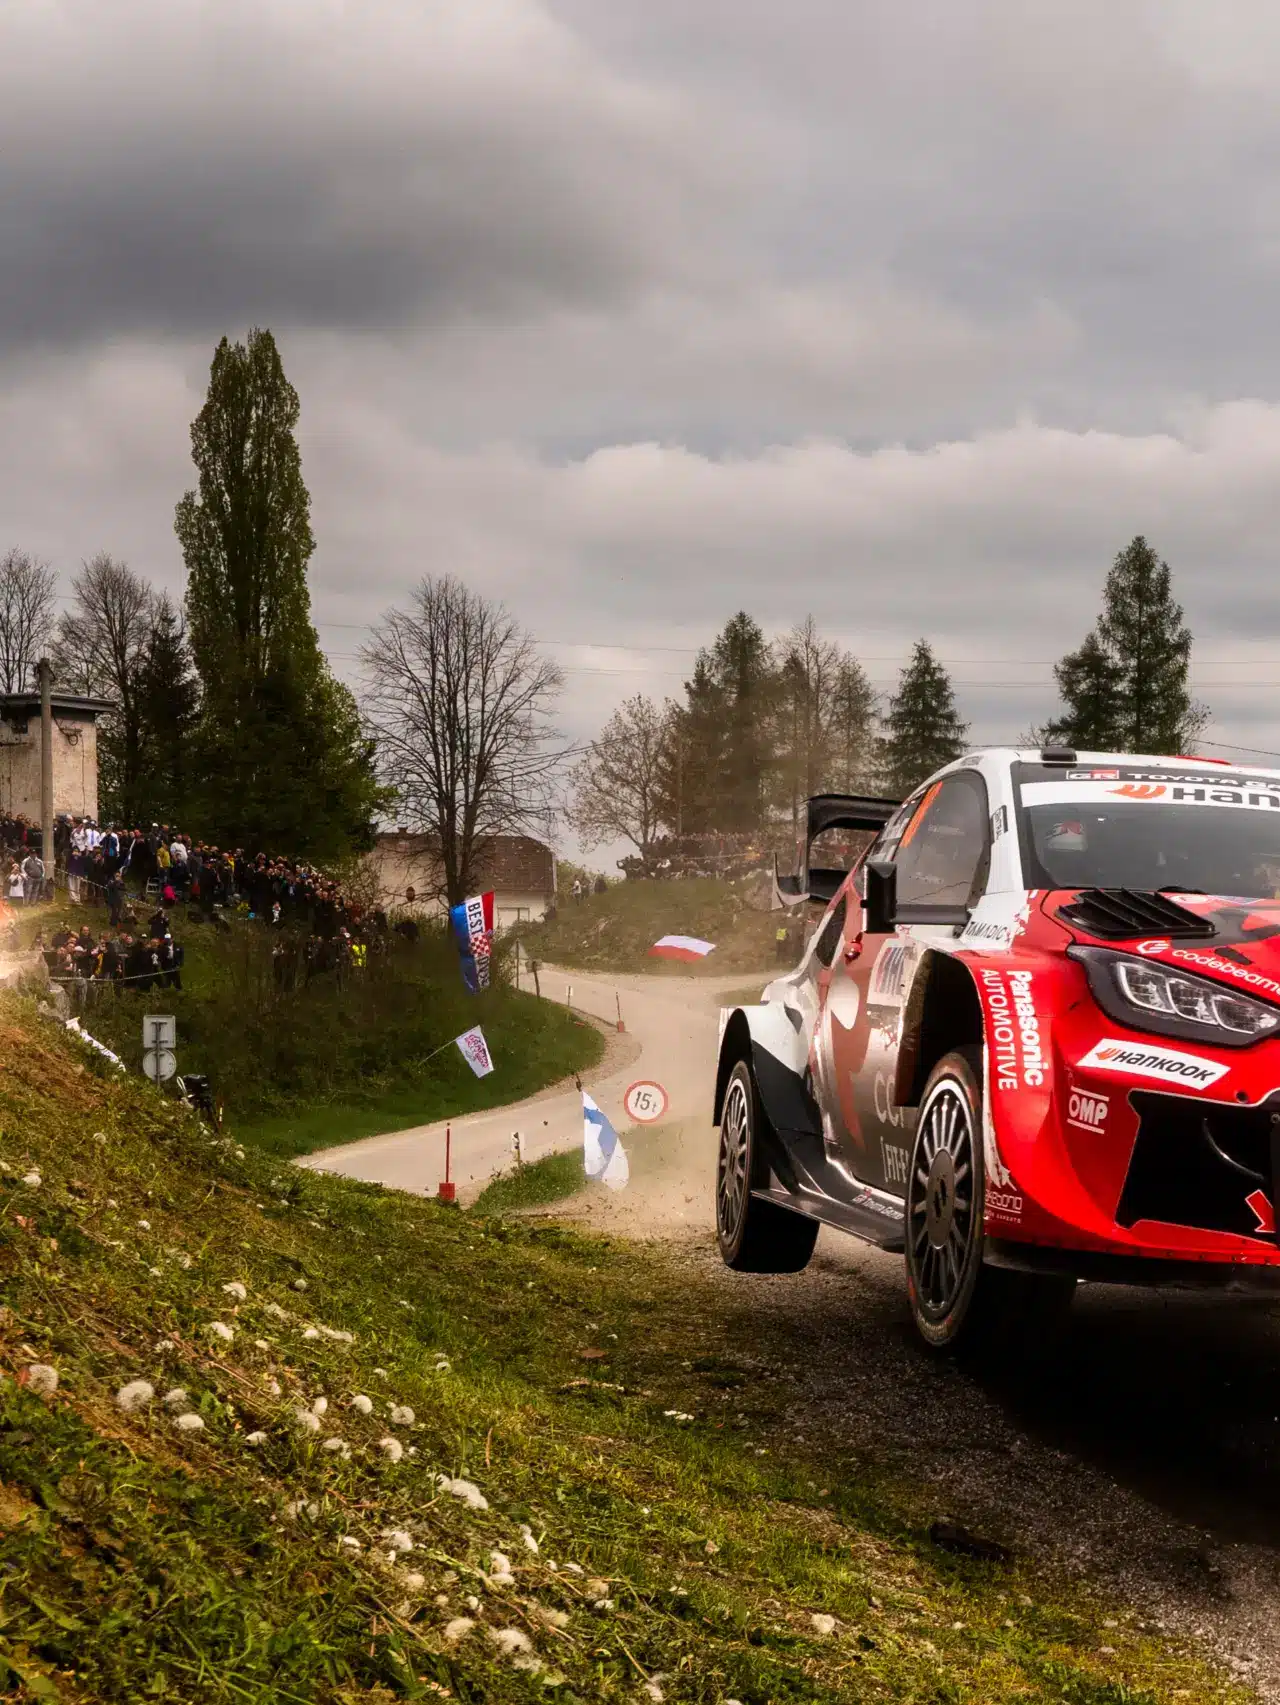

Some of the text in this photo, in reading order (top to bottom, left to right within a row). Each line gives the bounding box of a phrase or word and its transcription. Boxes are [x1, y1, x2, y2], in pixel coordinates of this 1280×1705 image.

[1127, 773, 1239, 785] TOYOTA
[467, 902, 484, 936] BEST
[966, 921, 1008, 941] TAMADIC
[980, 968, 1018, 1090] AUTOMOTIVE
[1006, 970, 1049, 1086] Panasonic
[633, 1090, 657, 1113] 15 t
[1068, 1093, 1108, 1126] OMP
